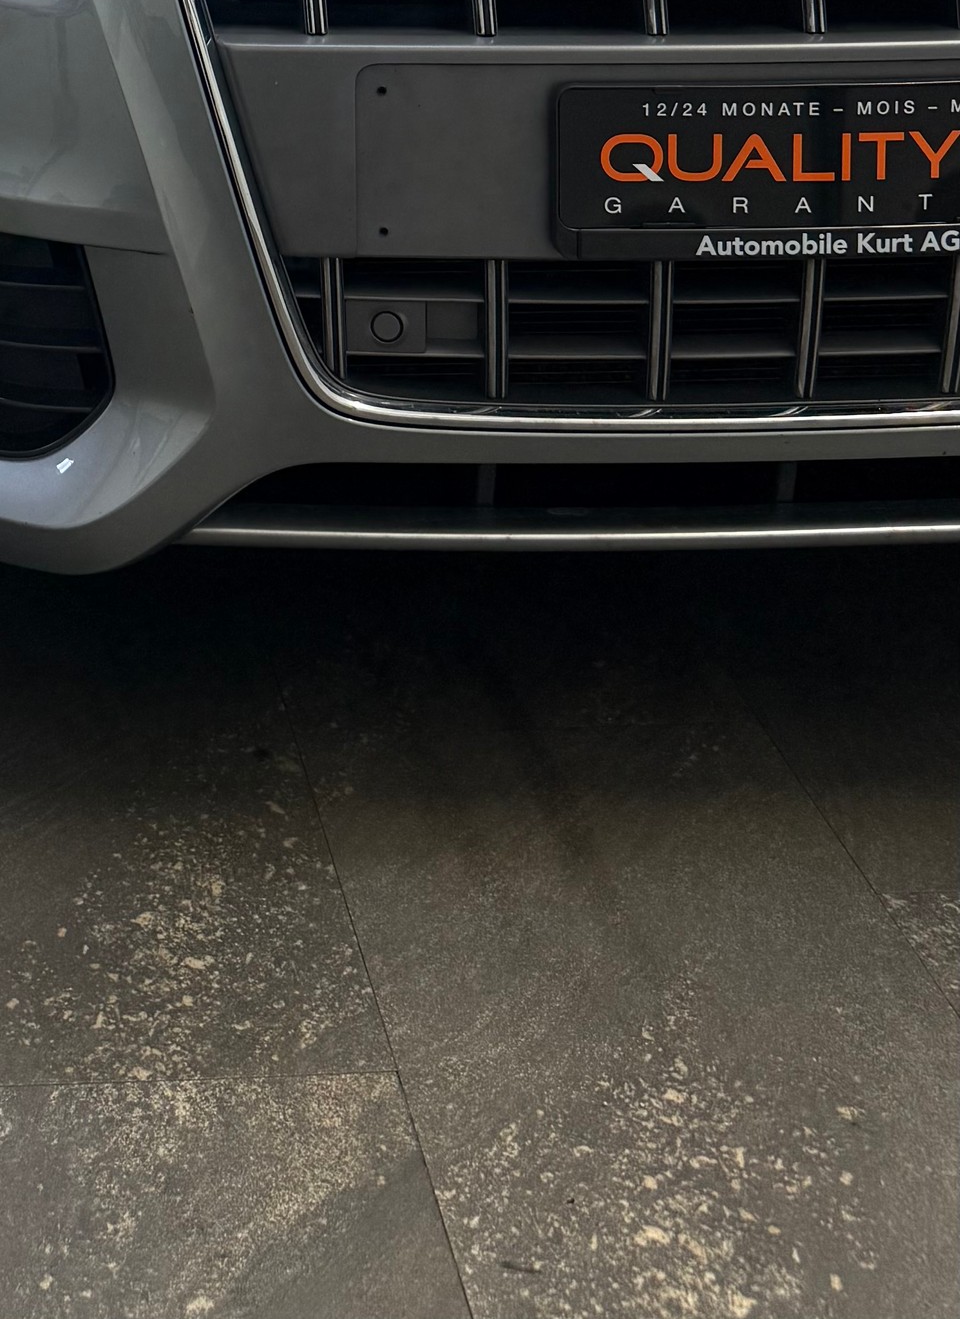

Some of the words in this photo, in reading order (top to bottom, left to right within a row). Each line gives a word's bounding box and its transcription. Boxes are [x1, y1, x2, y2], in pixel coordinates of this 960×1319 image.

[642, 102, 708, 117] 12/24
[721, 102, 821, 117] MONATE
[856, 100, 916, 115] MOIS
[600, 130, 960, 182] QUALITY
[695, 232, 848, 256] Automobile
[857, 233, 913, 254] Kurt
[920, 230, 960, 252] AG
